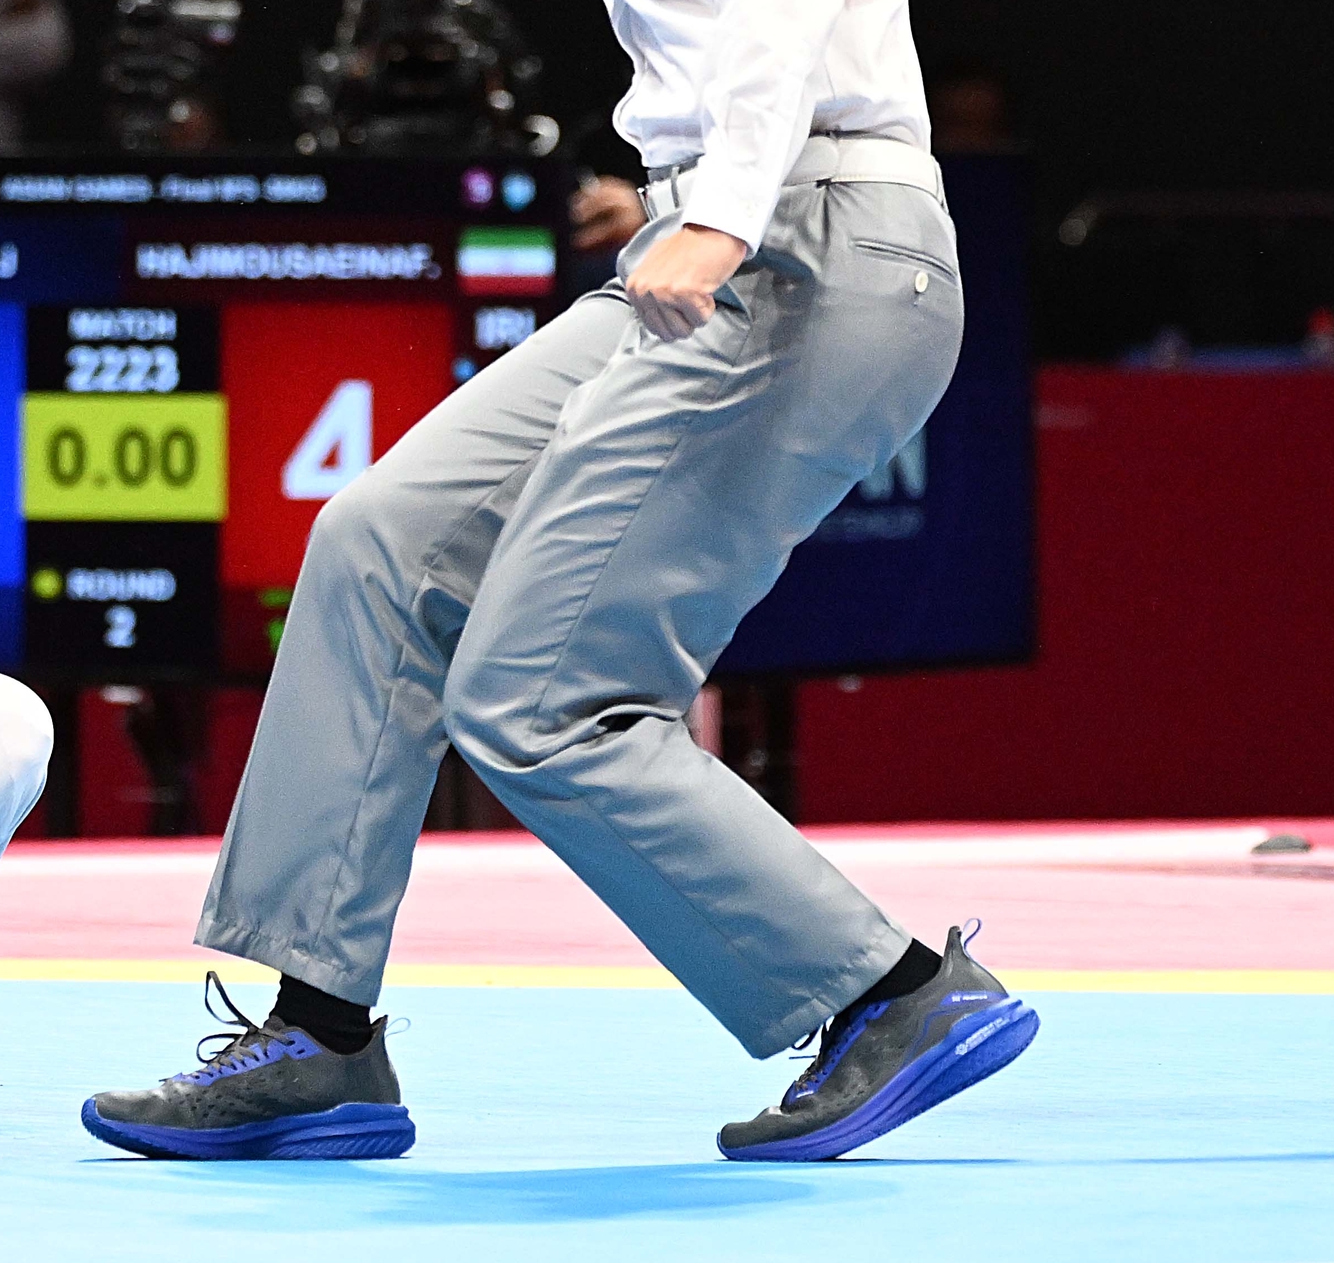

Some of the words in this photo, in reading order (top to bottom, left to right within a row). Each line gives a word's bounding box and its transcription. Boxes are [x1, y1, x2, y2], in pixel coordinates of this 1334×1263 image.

[69, 308, 177, 340] MATCH
[66, 345, 180, 392] 2223
[46, 425, 198, 488] 0.00
[281, 378, 374, 500] 4
[67, 568, 176, 601] ROUND
[104, 604, 136, 648] 2
